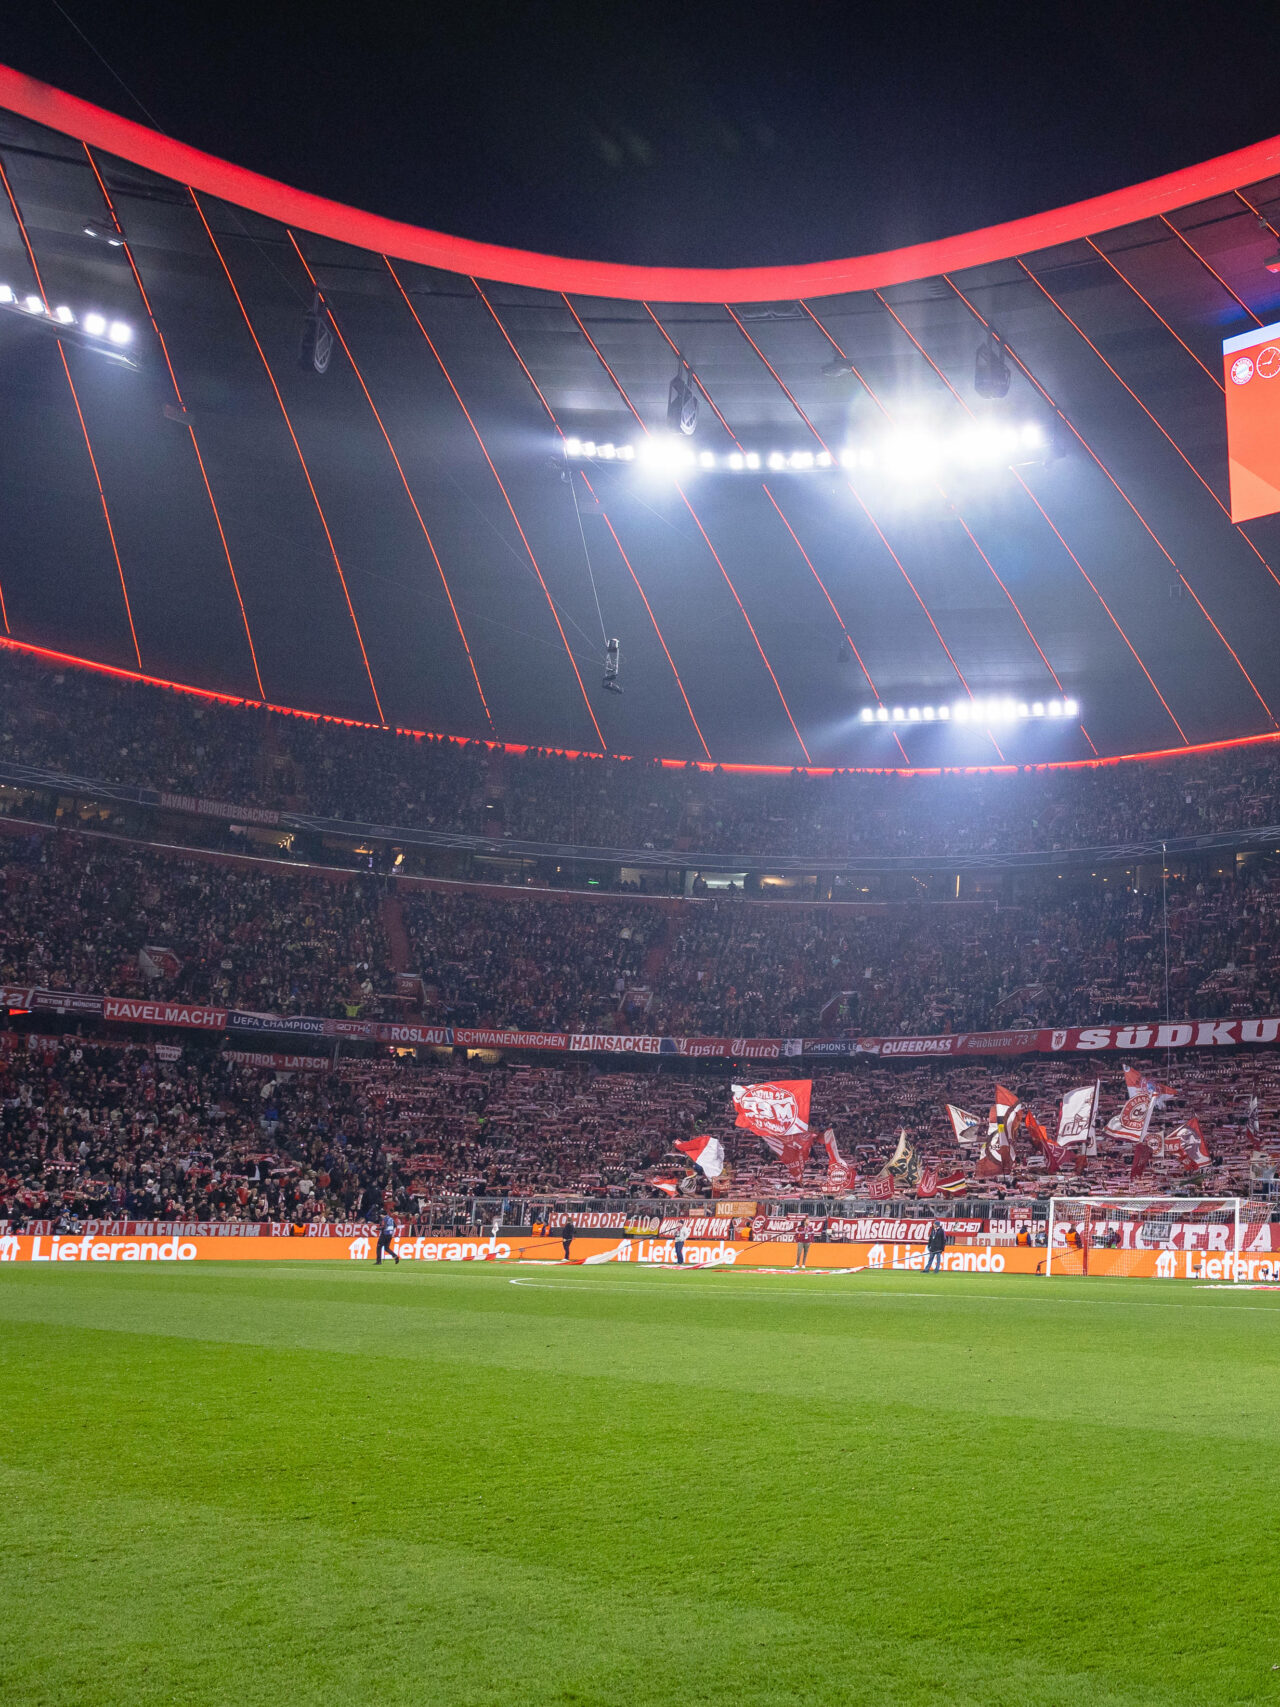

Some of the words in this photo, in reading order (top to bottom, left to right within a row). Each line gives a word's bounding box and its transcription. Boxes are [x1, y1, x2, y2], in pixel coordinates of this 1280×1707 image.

[106, 1002, 226, 1026] HAVELMACHT
[233, 1016, 260, 1027] UEFA
[262, 1018, 324, 1032] CHAMPIONS
[391, 1026, 444, 1044] RÖSLAU
[456, 1031, 566, 1047] SCHWANENKIRCHEN
[572, 1036, 660, 1053] HAINSACKER
[678, 1039, 725, 1057] Lipsia
[731, 1039, 780, 1058] United
[882, 1039, 953, 1054] QUEERPASS
[285, 1055, 329, 1069] LATSCH
[548, 1213, 627, 1229] ROHRDORF
[134, 1223, 261, 1236] KLEINOSTHEIM
[32, 1235, 198, 1261] Lieferando
